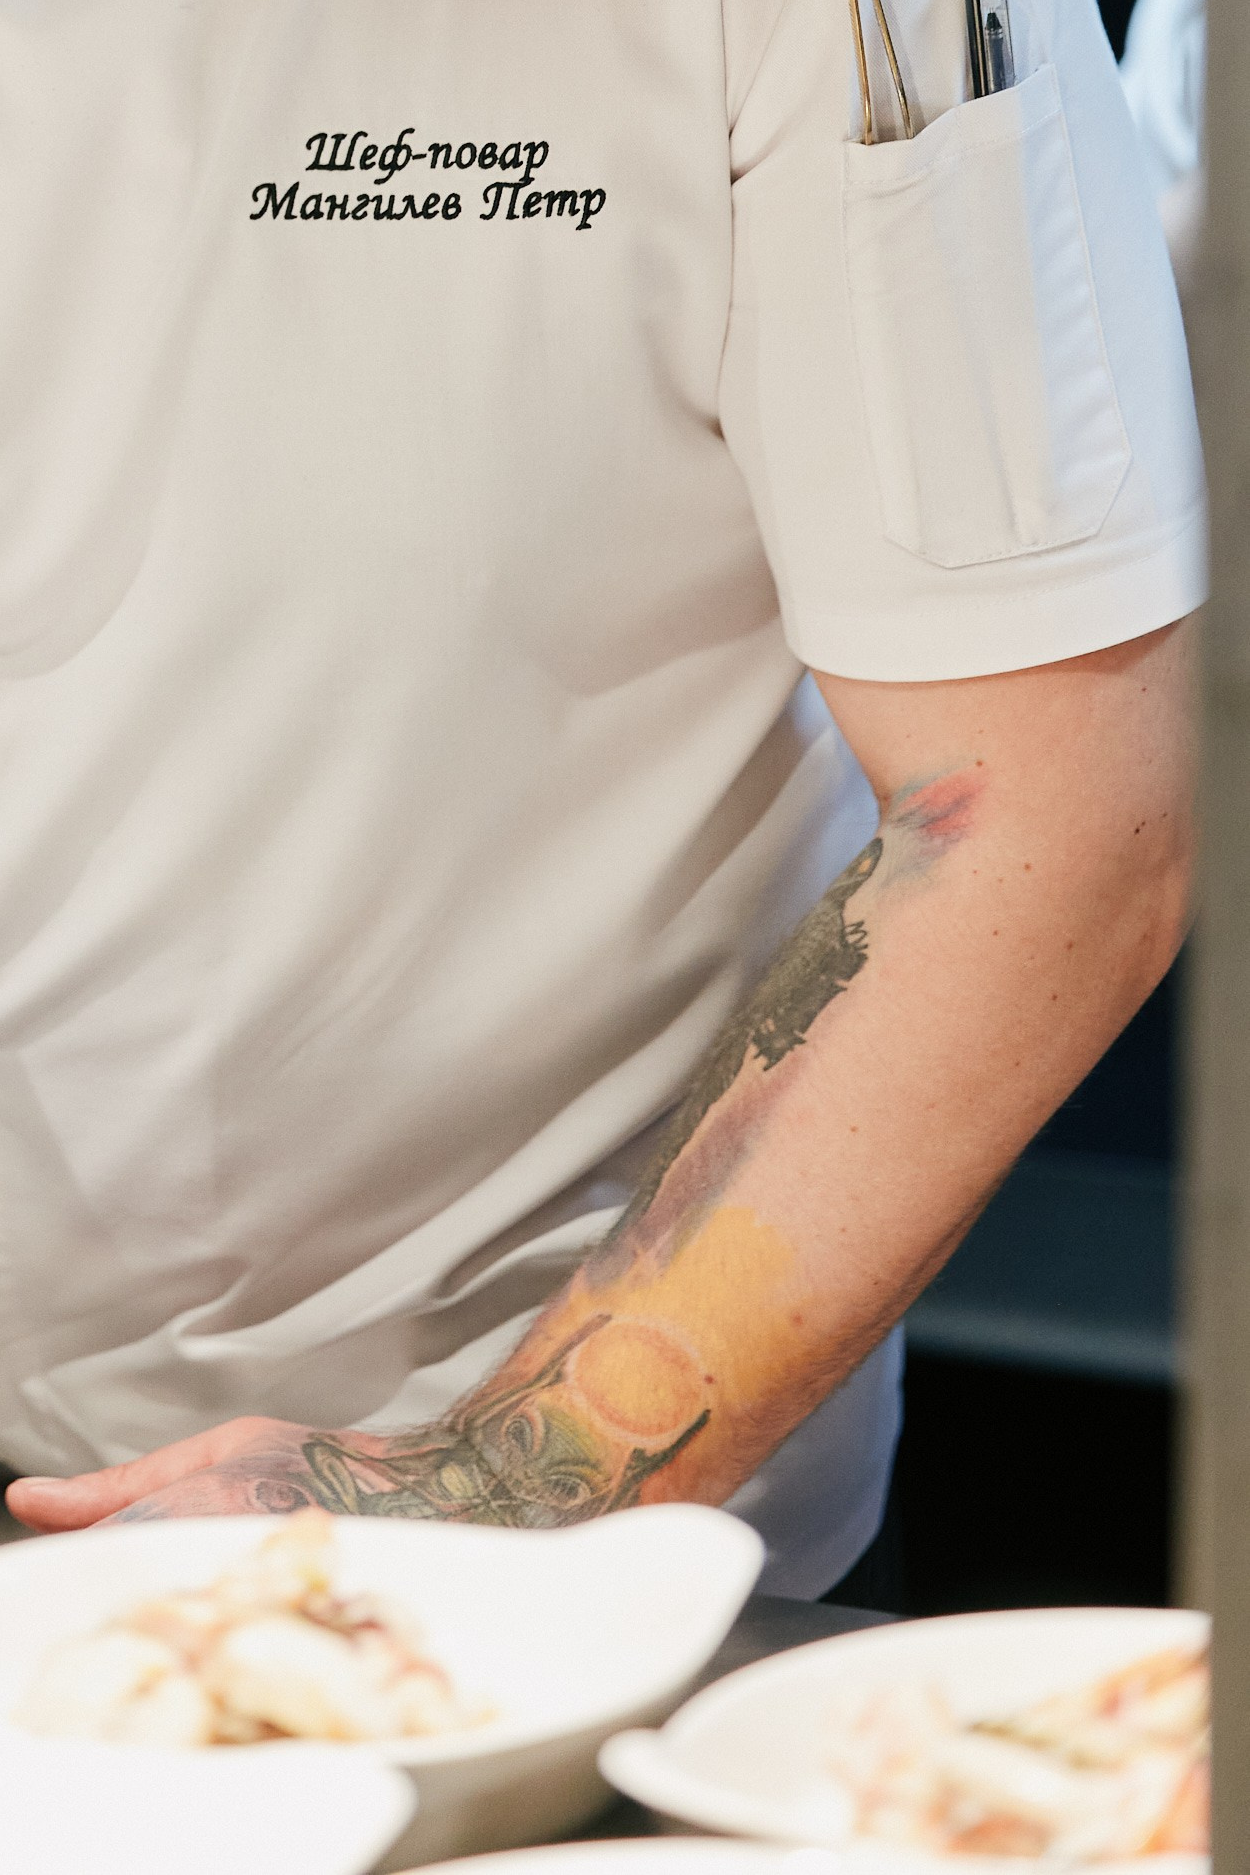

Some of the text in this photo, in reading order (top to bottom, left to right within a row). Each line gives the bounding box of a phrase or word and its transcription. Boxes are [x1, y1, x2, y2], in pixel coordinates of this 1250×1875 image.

[305, 128, 550, 184] Шеф-повар
[250, 180, 607, 231] Мангилев Петр
